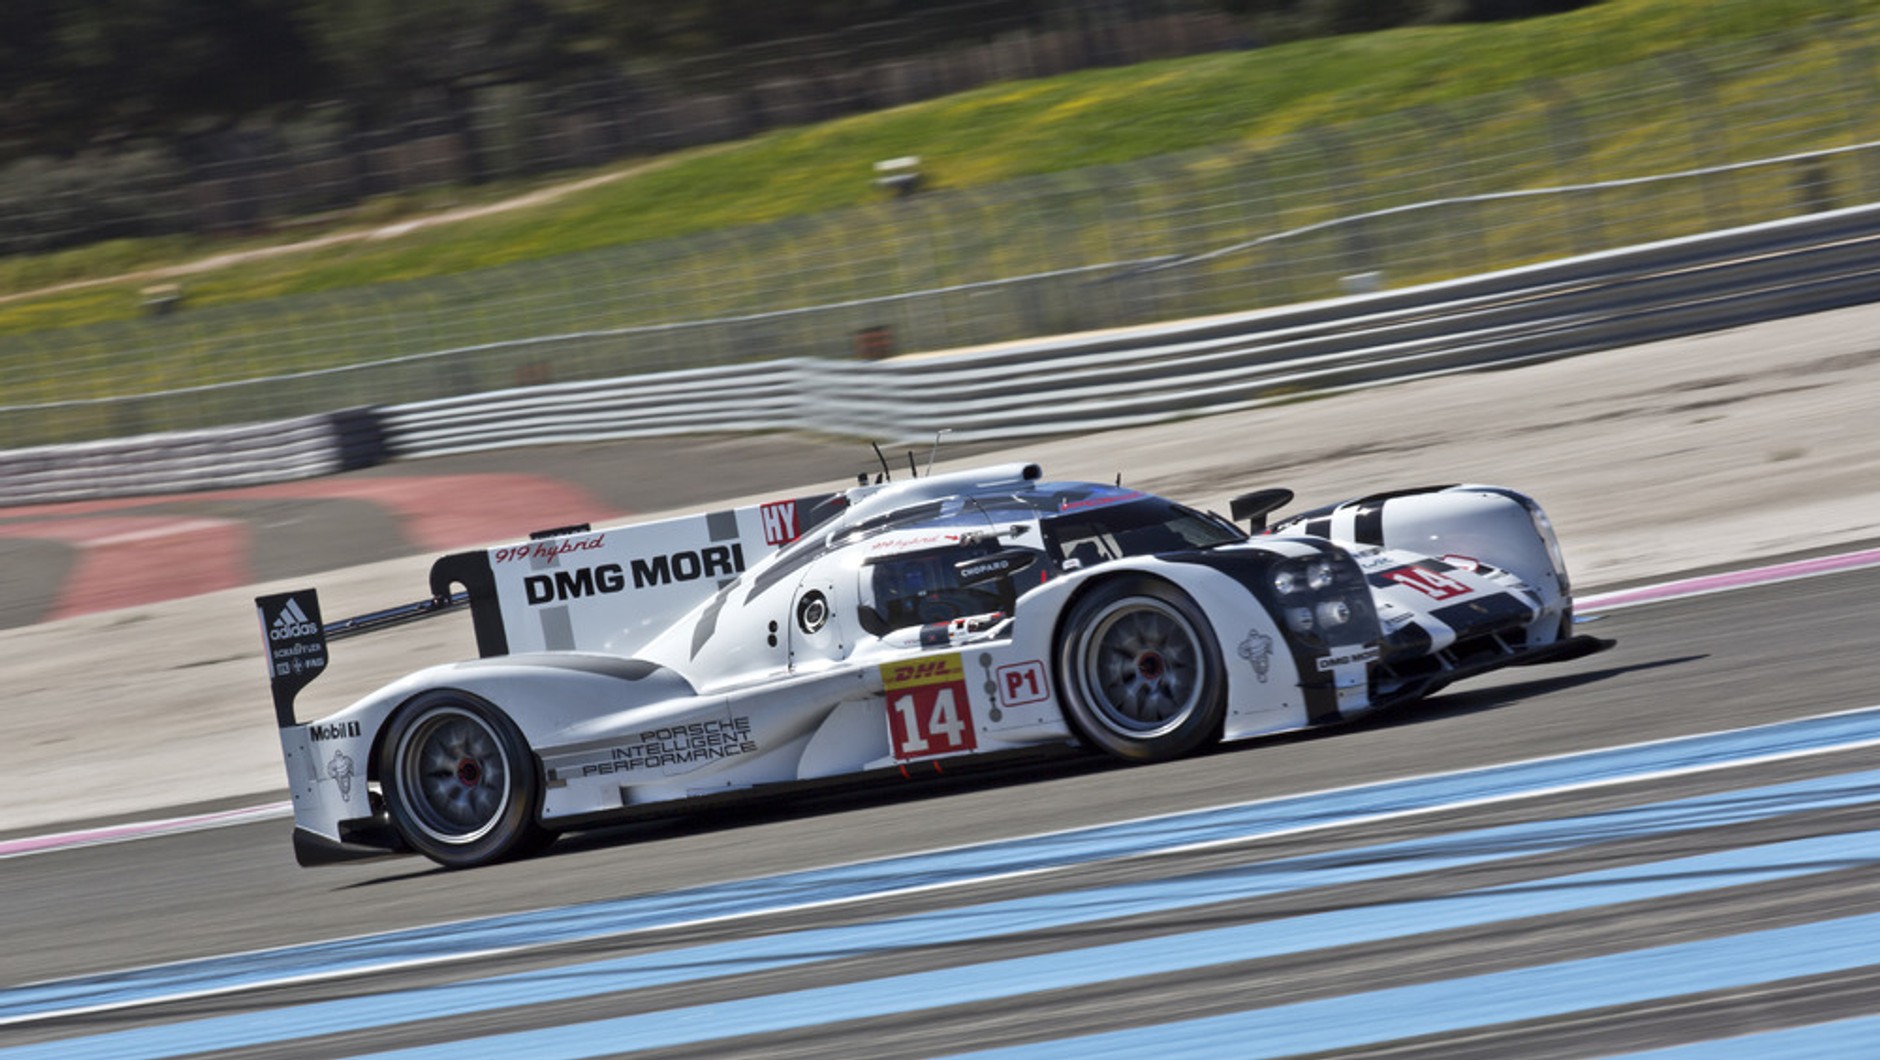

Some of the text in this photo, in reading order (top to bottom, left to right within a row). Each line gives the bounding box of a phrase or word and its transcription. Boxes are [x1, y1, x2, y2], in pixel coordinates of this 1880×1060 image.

[763, 502, 795, 542] HY
[495, 534, 605, 564] 919 hybrid
[524, 543, 746, 606] DMG MORI
[270, 622, 318, 641] adidas
[895, 660, 951, 683] DHL
[1006, 668, 1039, 699] P1
[309, 721, 347, 742] Mobil
[640, 715, 751, 744] PORSCHE
[894, 687, 967, 754] 14
[582, 740, 758, 778] PERFORMANCE
[611, 729, 751, 761] INTELLIGENT
